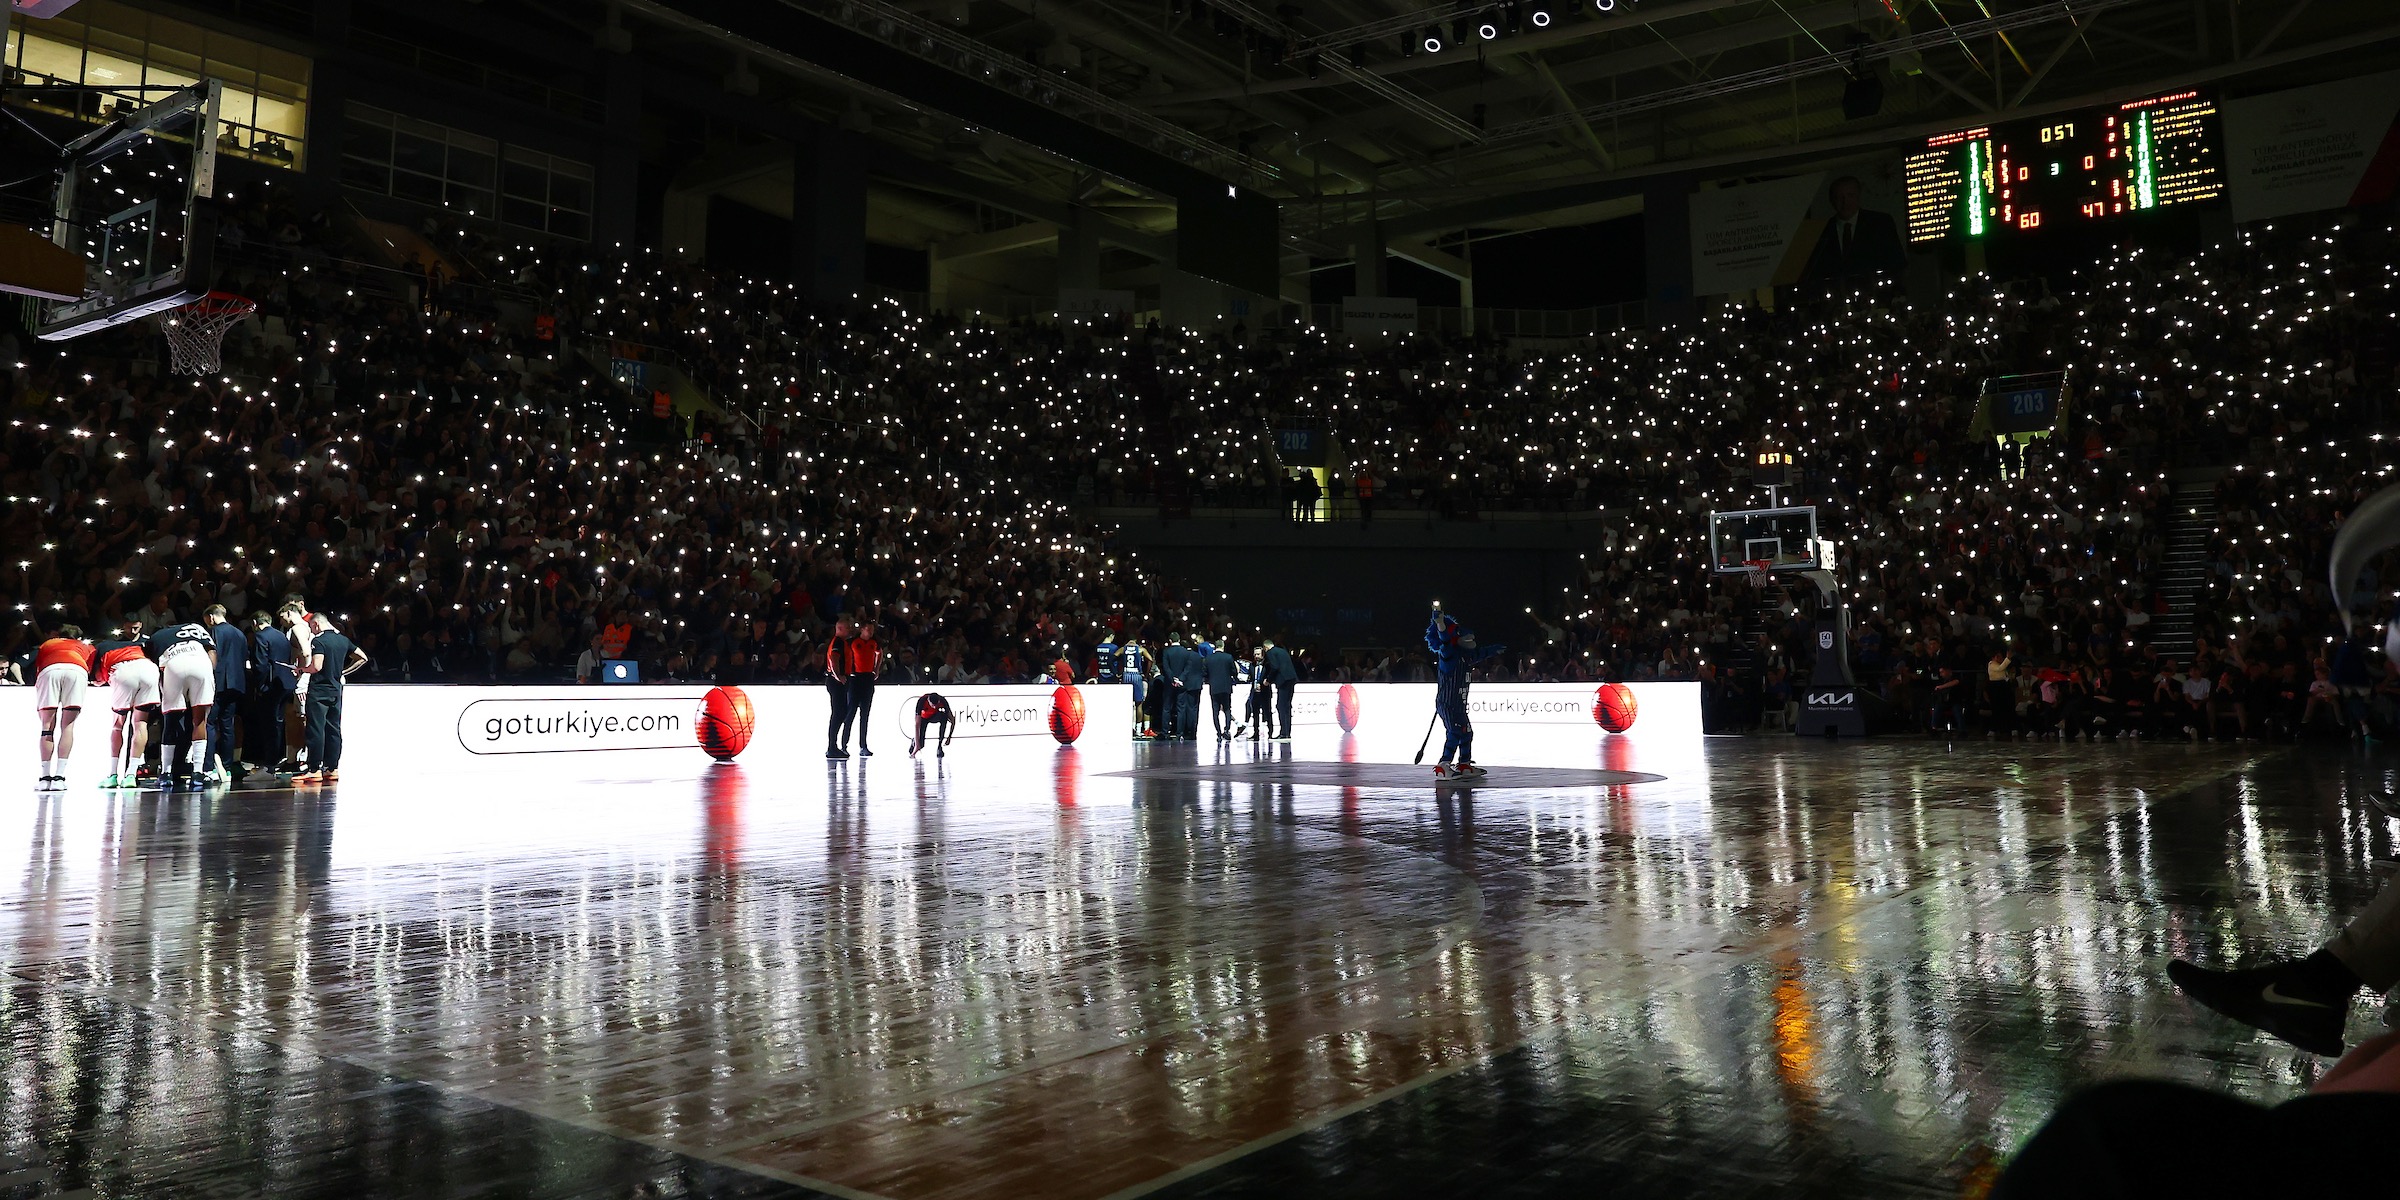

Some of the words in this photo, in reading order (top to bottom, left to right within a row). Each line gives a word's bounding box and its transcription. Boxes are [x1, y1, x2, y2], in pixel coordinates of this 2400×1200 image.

[2050, 163, 2059, 175] 3
[2084, 155, 2093, 169] 0
[2019, 167, 2028, 180] 0
[2083, 202, 2103, 218] 47
[2020, 212, 2040, 229] 60
[1344, 311, 1375, 319] ISUZU
[2013, 392, 2044, 415] 203
[1283, 431, 1308, 450] 202
[485, 710, 679, 741] goturkiye.com
